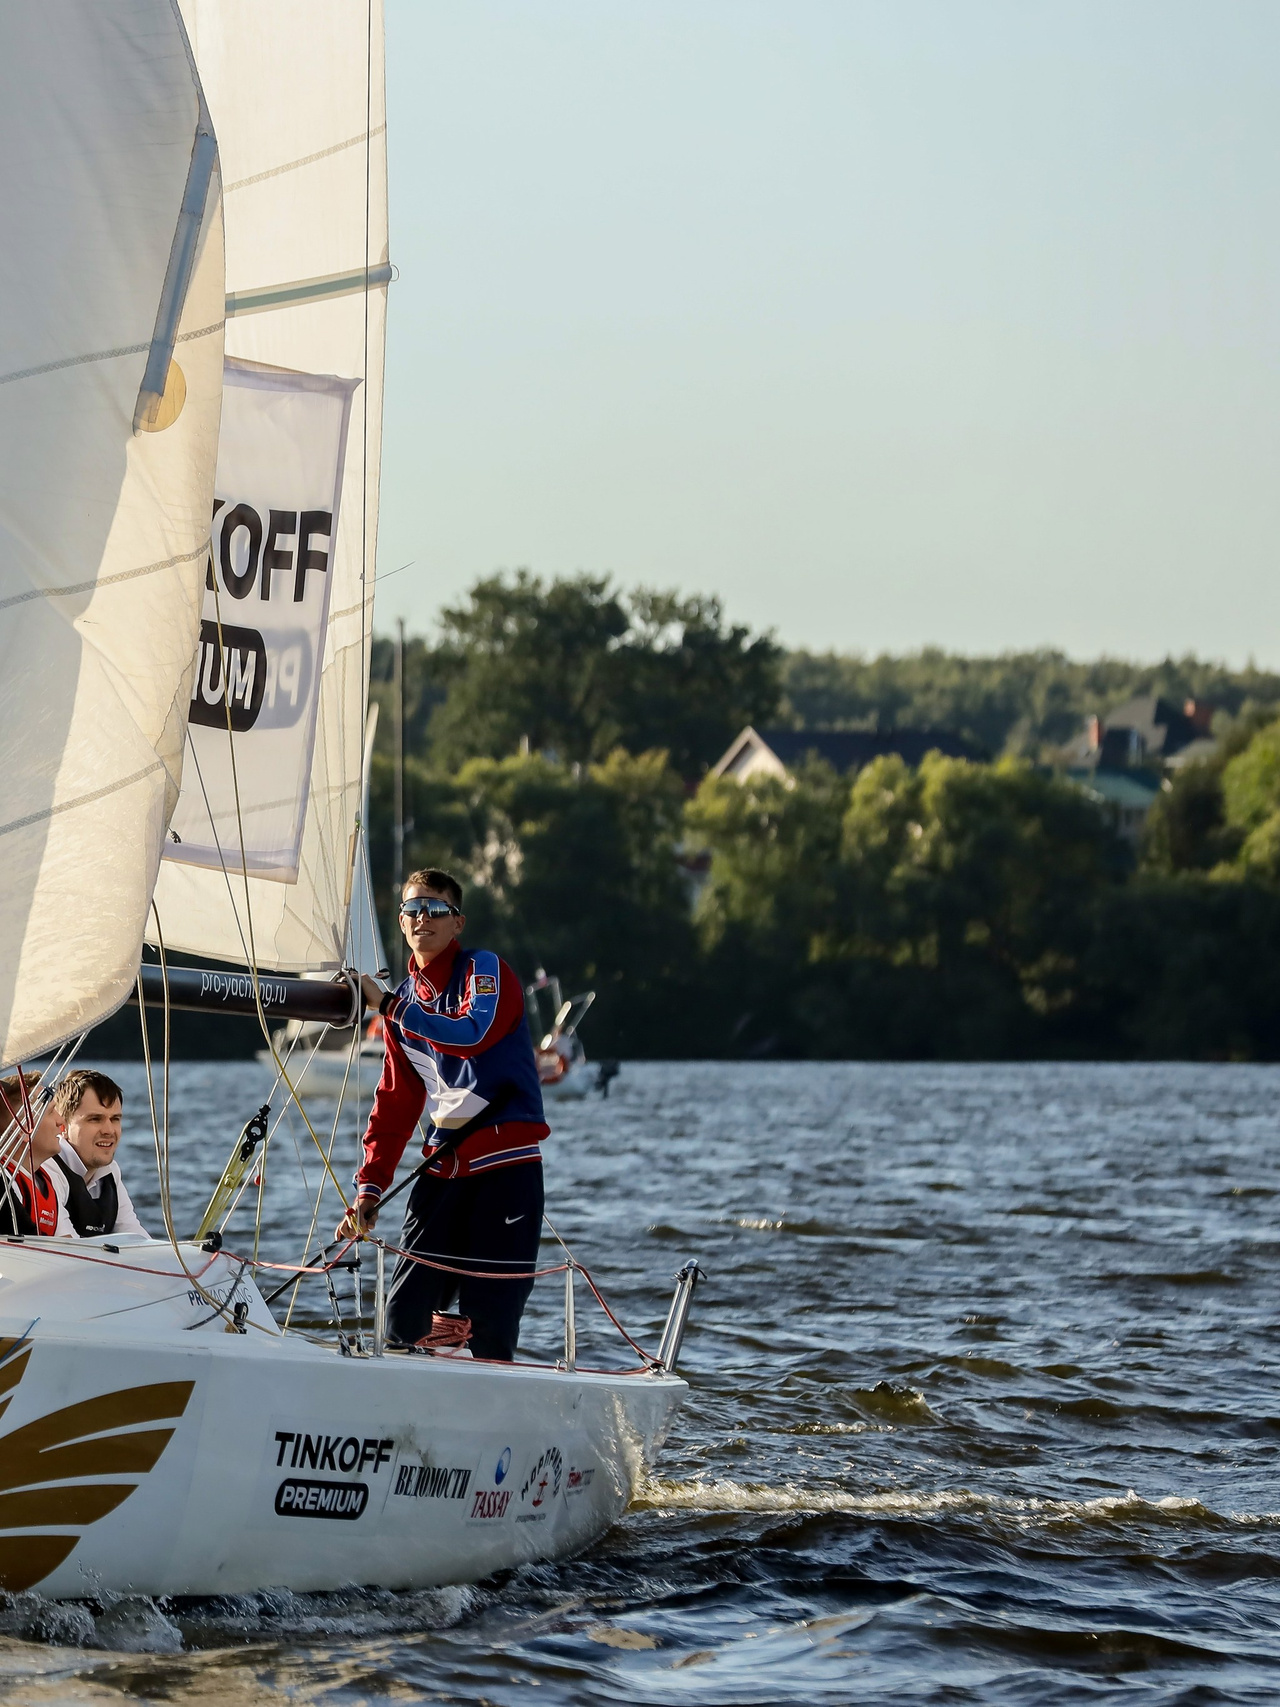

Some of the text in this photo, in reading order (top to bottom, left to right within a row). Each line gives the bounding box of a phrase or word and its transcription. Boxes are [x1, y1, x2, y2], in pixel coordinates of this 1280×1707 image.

[201, 972, 287, 1008] pro-yachtng.ru
[275, 1431, 395, 1474] TINKOFF
[280, 1485, 364, 1513] PREMIUM
[394, 1464, 472, 1500] ВЕДОМОСТИ
[471, 1490, 513, 1518] TASSAY
